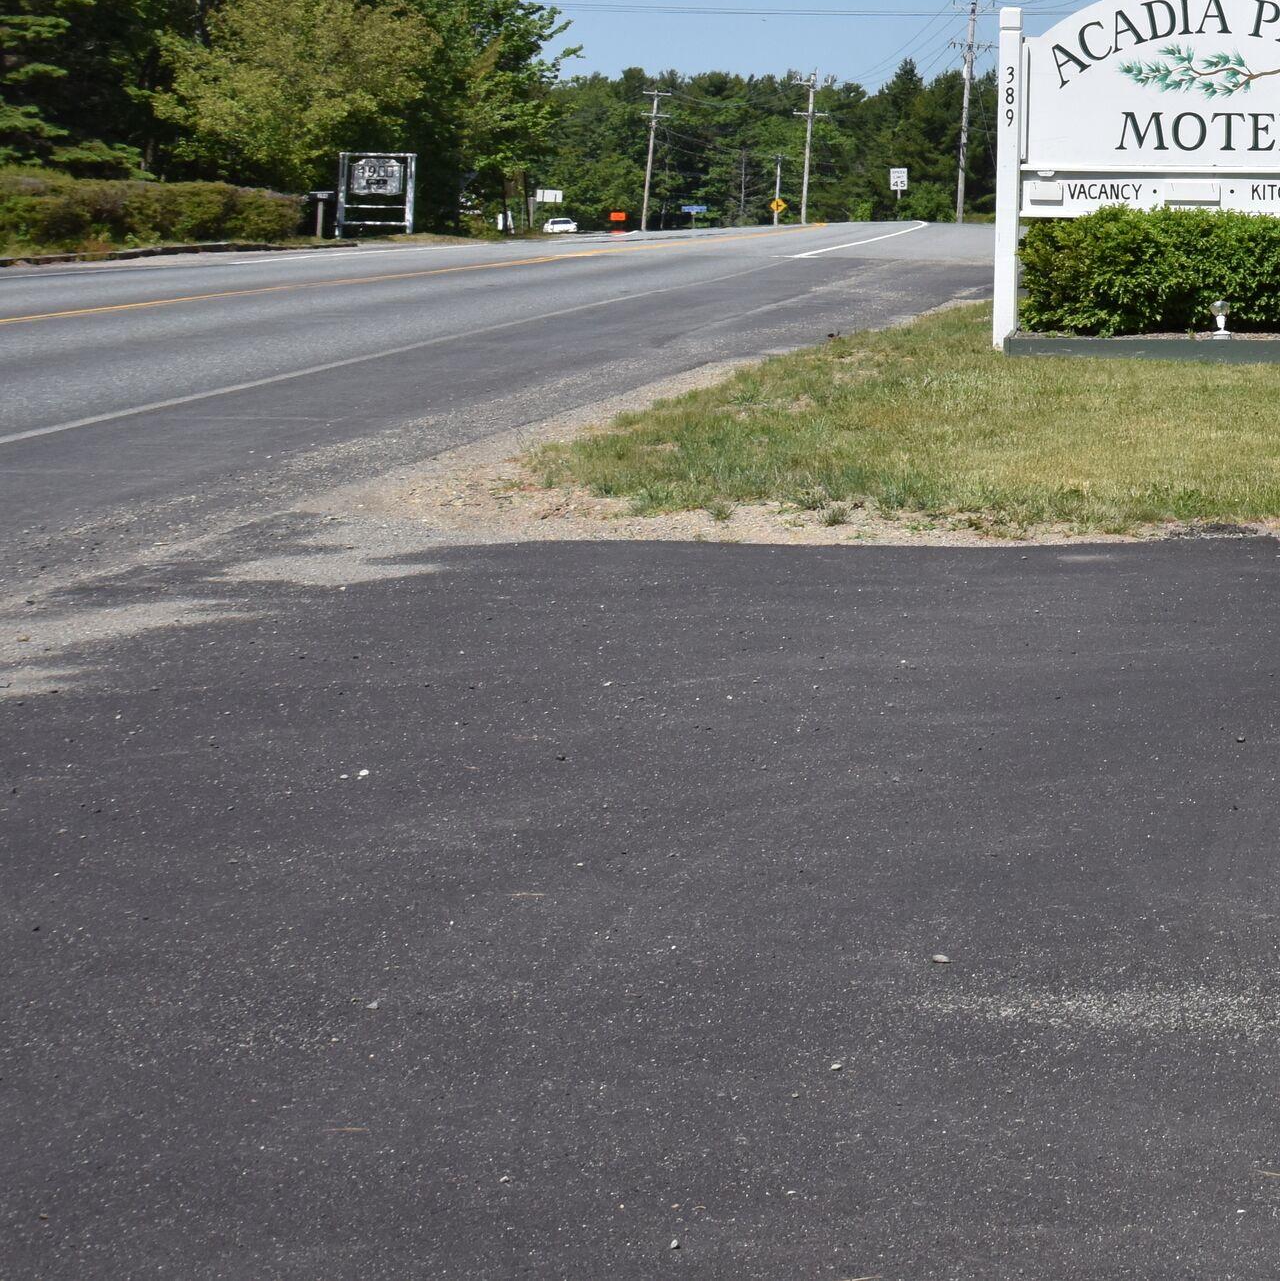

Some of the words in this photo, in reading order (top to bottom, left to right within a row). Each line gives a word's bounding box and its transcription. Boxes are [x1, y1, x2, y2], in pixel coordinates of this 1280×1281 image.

[1006, 66, 1015, 127] 389
[892, 180, 905, 188] 45
[1067, 183, 1143, 201] VACANCY
